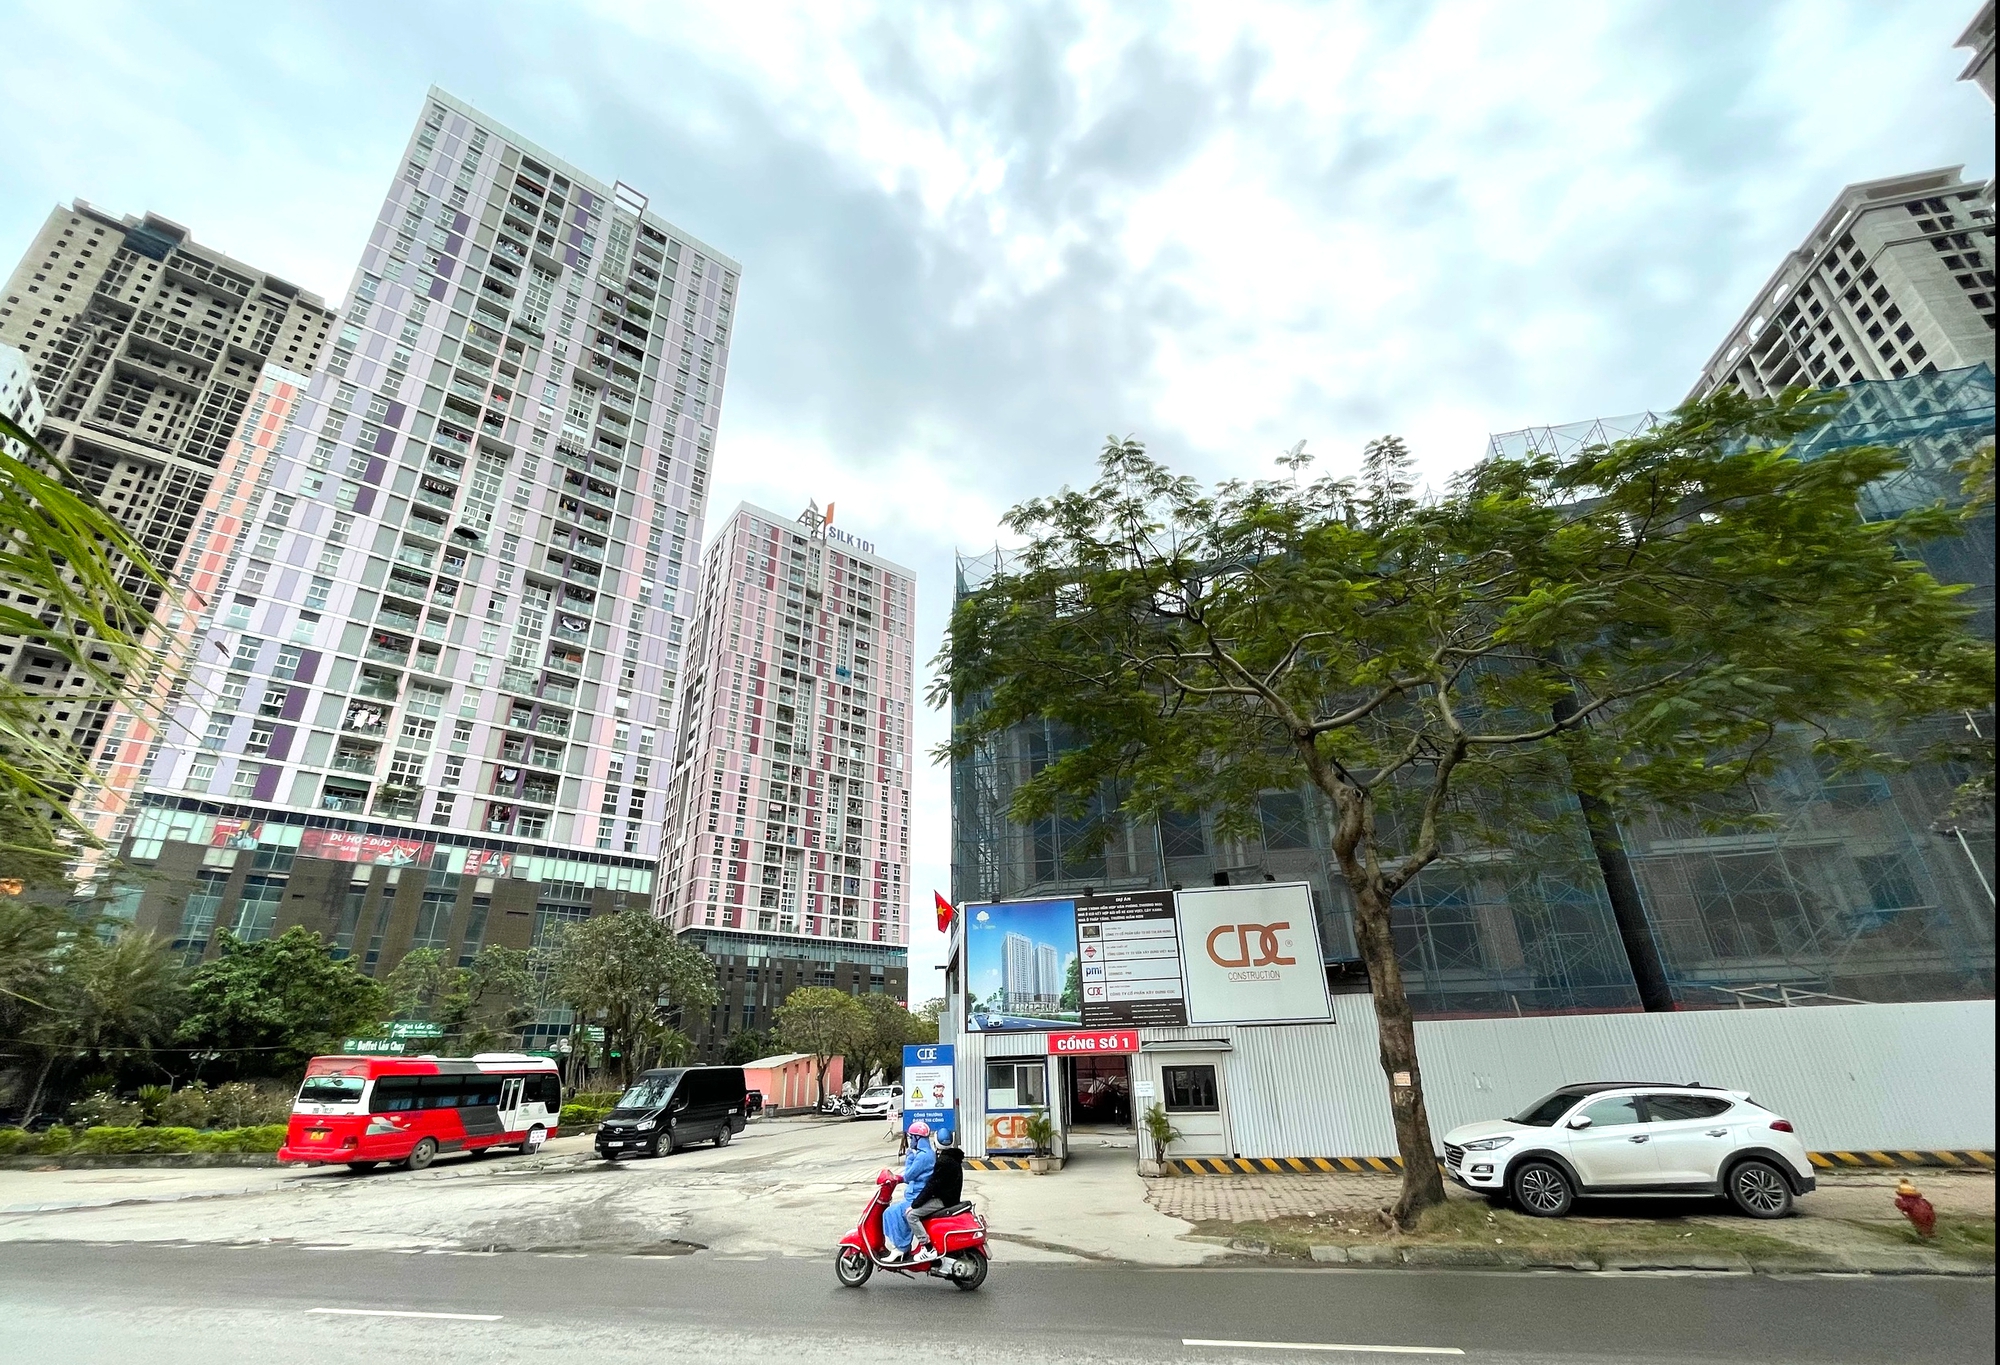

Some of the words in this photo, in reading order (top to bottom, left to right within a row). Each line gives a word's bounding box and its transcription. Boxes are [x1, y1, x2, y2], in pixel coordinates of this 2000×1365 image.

[829, 526, 854, 546] SILK
[856, 538, 875, 555] 101
[1206, 922, 1296, 967] CDC
[1086, 966, 1102, 977] pmi
[1228, 970, 1280, 981] CONSTRUCTION
[357, 1040, 377, 1051] Buffet
[1057, 1035, 1095, 1050] CỔNG
[1099, 1034, 1118, 1049] SỐ
[1121, 1037, 1129, 1048] 1
